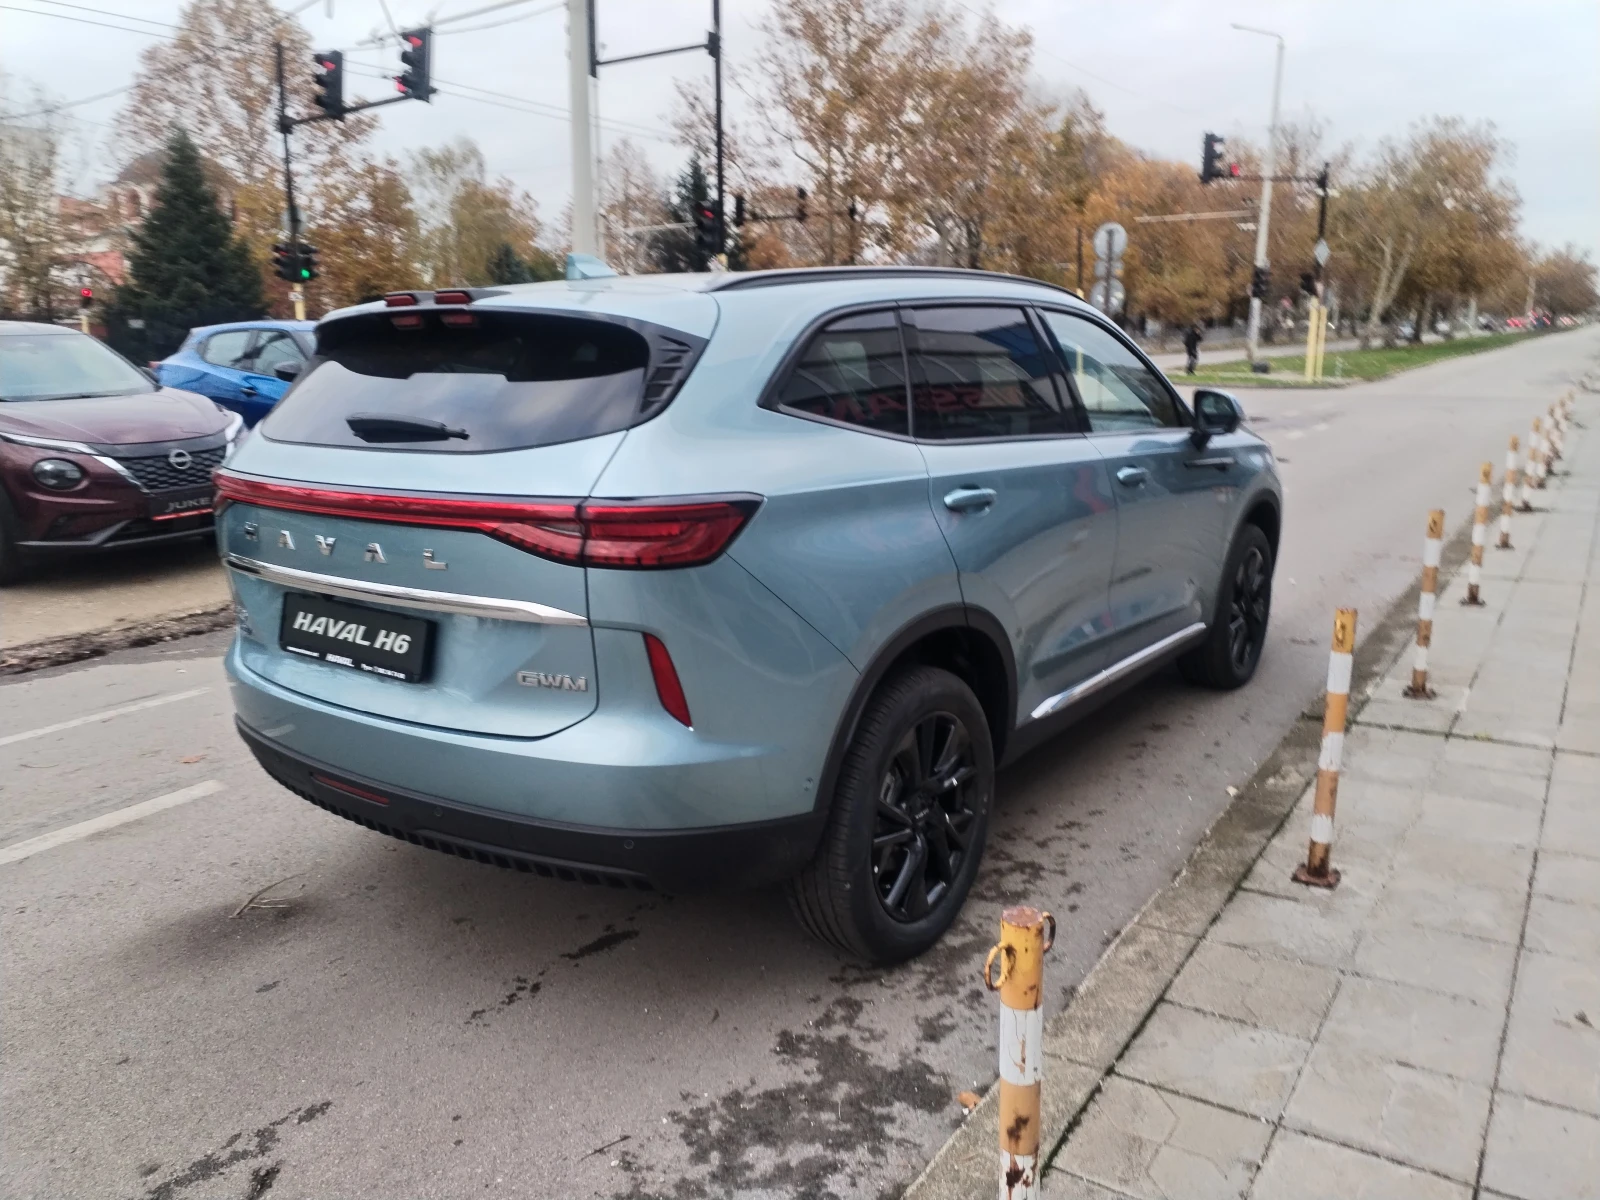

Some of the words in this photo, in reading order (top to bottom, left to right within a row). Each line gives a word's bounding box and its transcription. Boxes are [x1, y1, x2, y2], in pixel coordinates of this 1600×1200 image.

[164, 496, 212, 513] JUKE
[244, 521, 449, 570] HAVAL
[292, 611, 371, 647] HAVAL
[373, 629, 412, 654] H6
[516, 670, 588, 692] GWM
